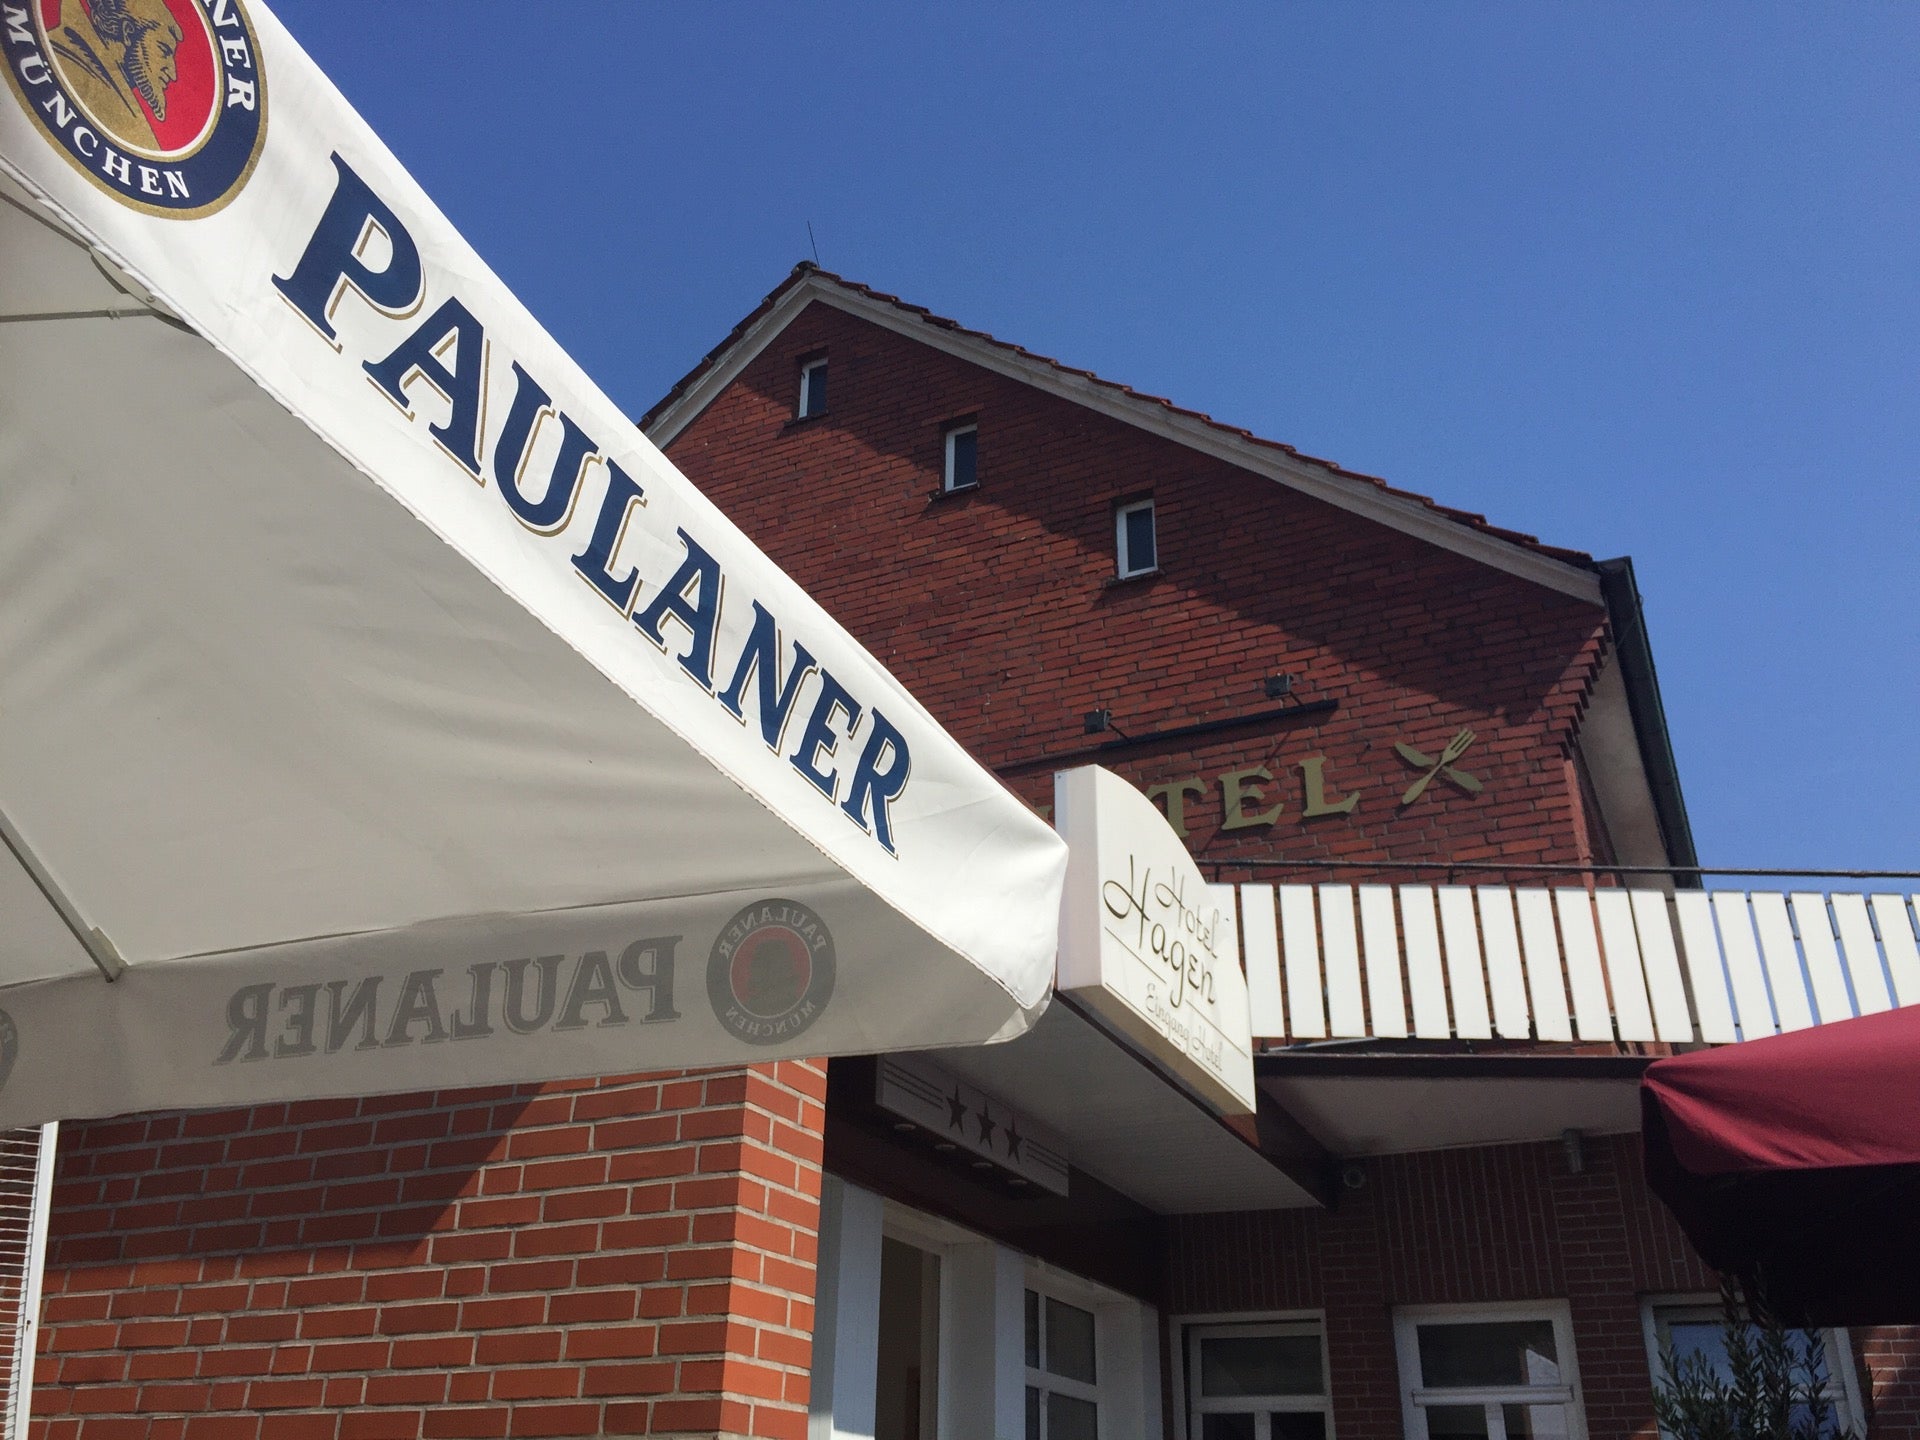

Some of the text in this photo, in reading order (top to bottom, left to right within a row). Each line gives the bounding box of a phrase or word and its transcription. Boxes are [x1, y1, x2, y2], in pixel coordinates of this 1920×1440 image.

[2, 2, 190, 199] MÜNCHEN
[270, 149, 912, 861] PAULANER
[1036, 755, 1361, 838] TEL
[1102, 853, 1217, 1009] Hagen
[1154, 865, 1218, 959] Hotel
